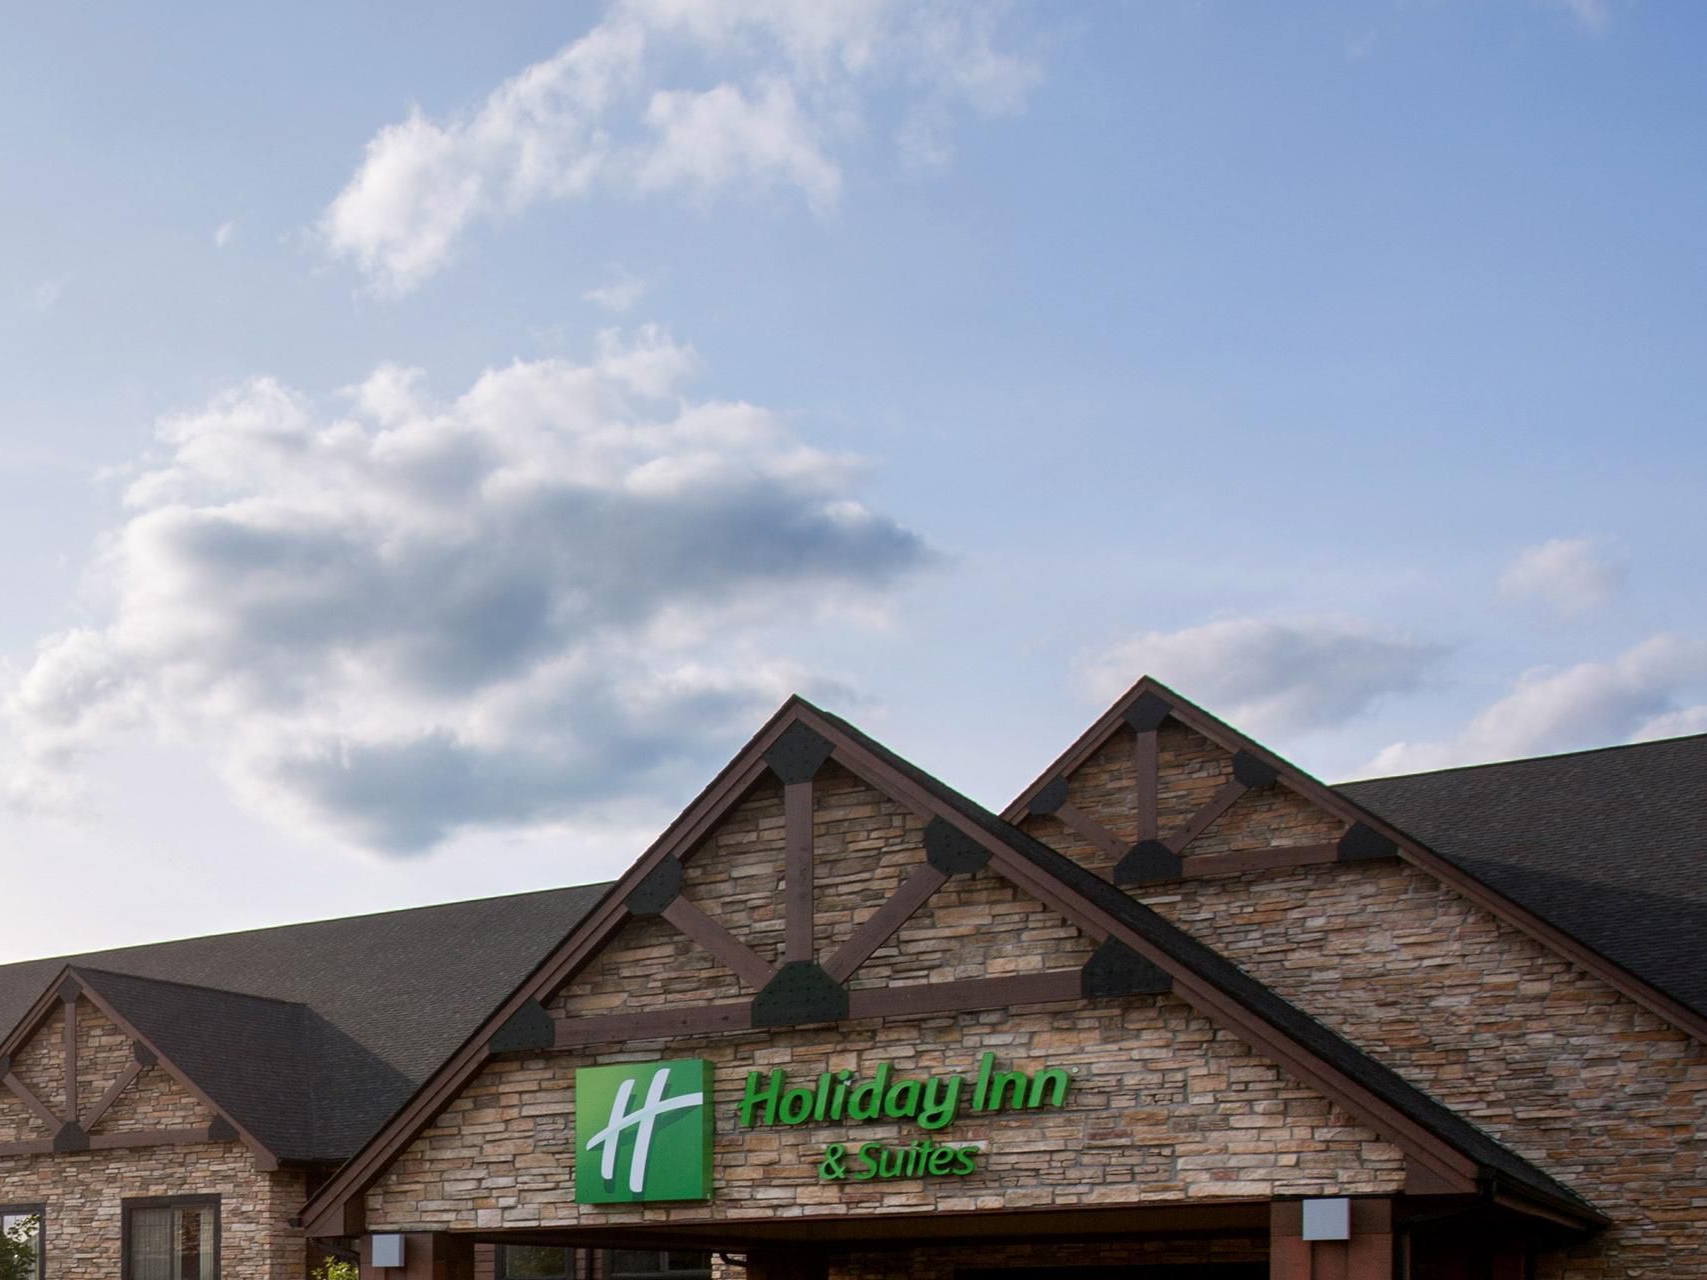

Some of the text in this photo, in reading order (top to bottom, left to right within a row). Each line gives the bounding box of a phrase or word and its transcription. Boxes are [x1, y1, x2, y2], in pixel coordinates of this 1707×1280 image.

[737, 1051, 1072, 1130] Holiday Inn
[819, 1139, 981, 1180] & Suites
